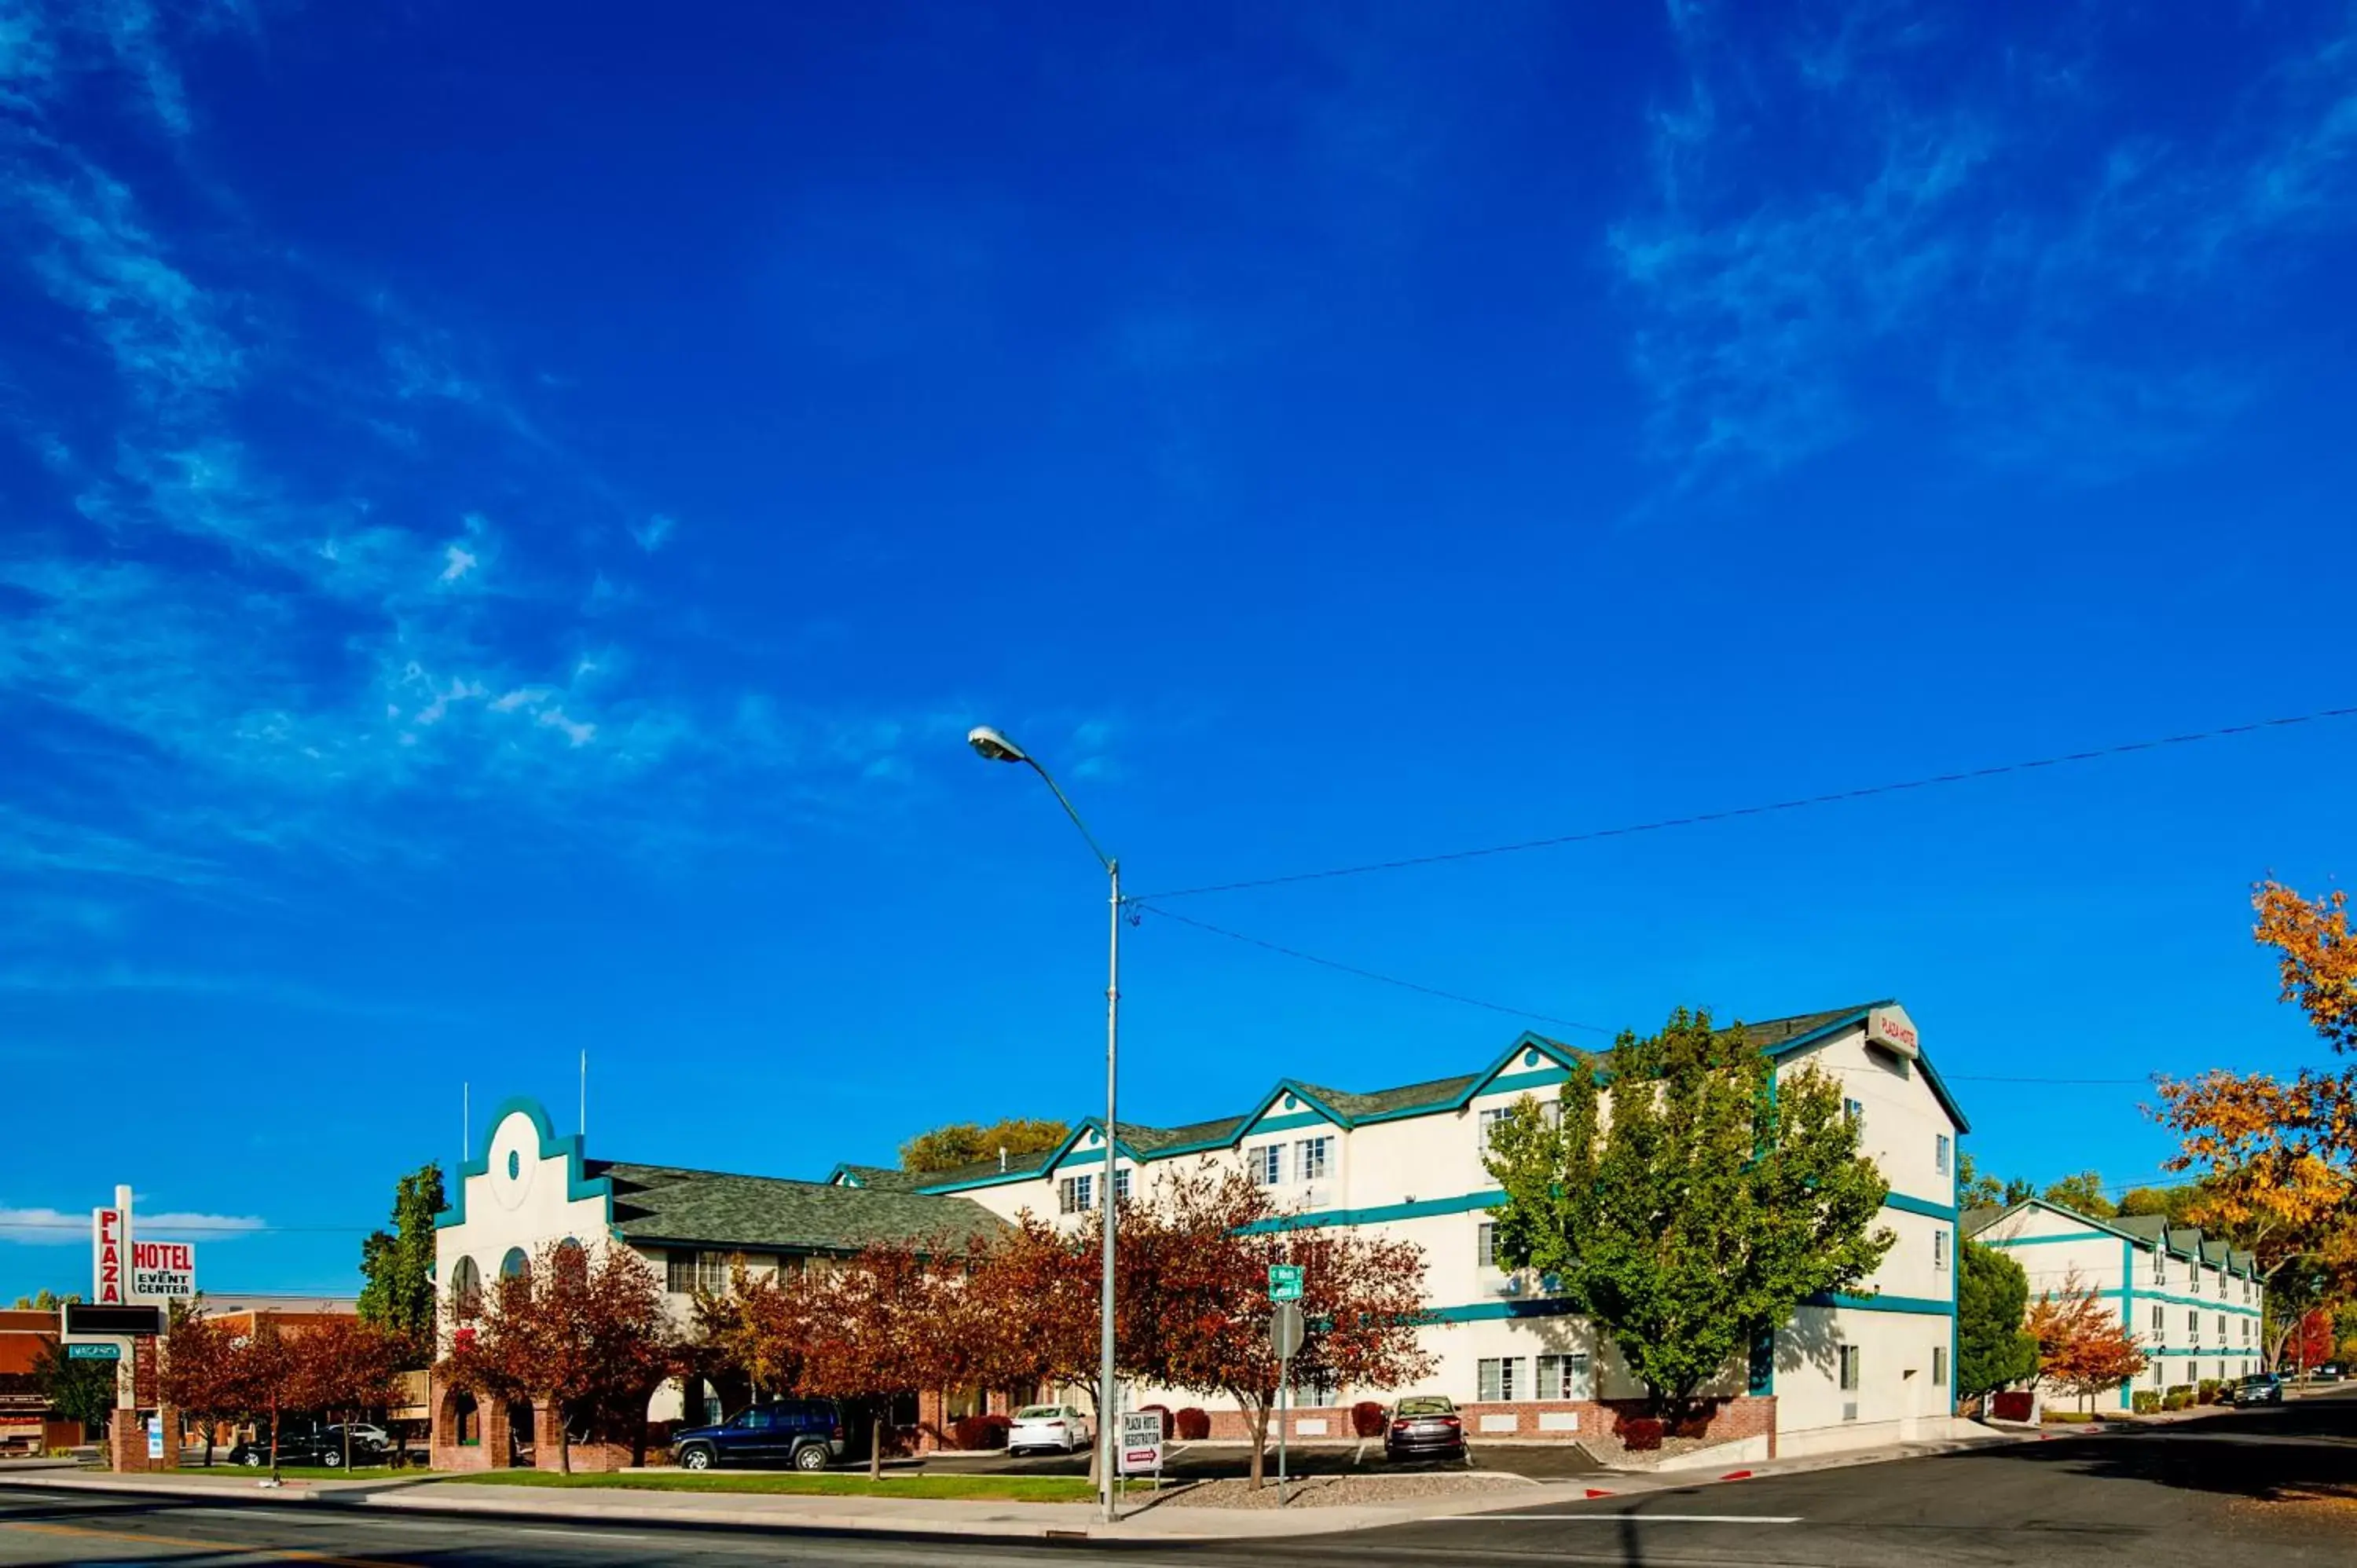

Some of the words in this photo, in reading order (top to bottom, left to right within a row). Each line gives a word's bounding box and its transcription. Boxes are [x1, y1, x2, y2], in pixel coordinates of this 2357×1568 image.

[1881, 1017, 1899, 1039] PLAZA
[1899, 1027, 1915, 1049] HOTEL
[101, 1211, 119, 1302] PLAZA
[134, 1244, 192, 1270] HOTEL
[137, 1273, 189, 1284] EVENT
[137, 1284, 189, 1295] CENTER
[1124, 1416, 1142, 1431] PLAZA
[1143, 1416, 1159, 1430] HOTEL
[1124, 1432, 1159, 1446] REGISTRATION
